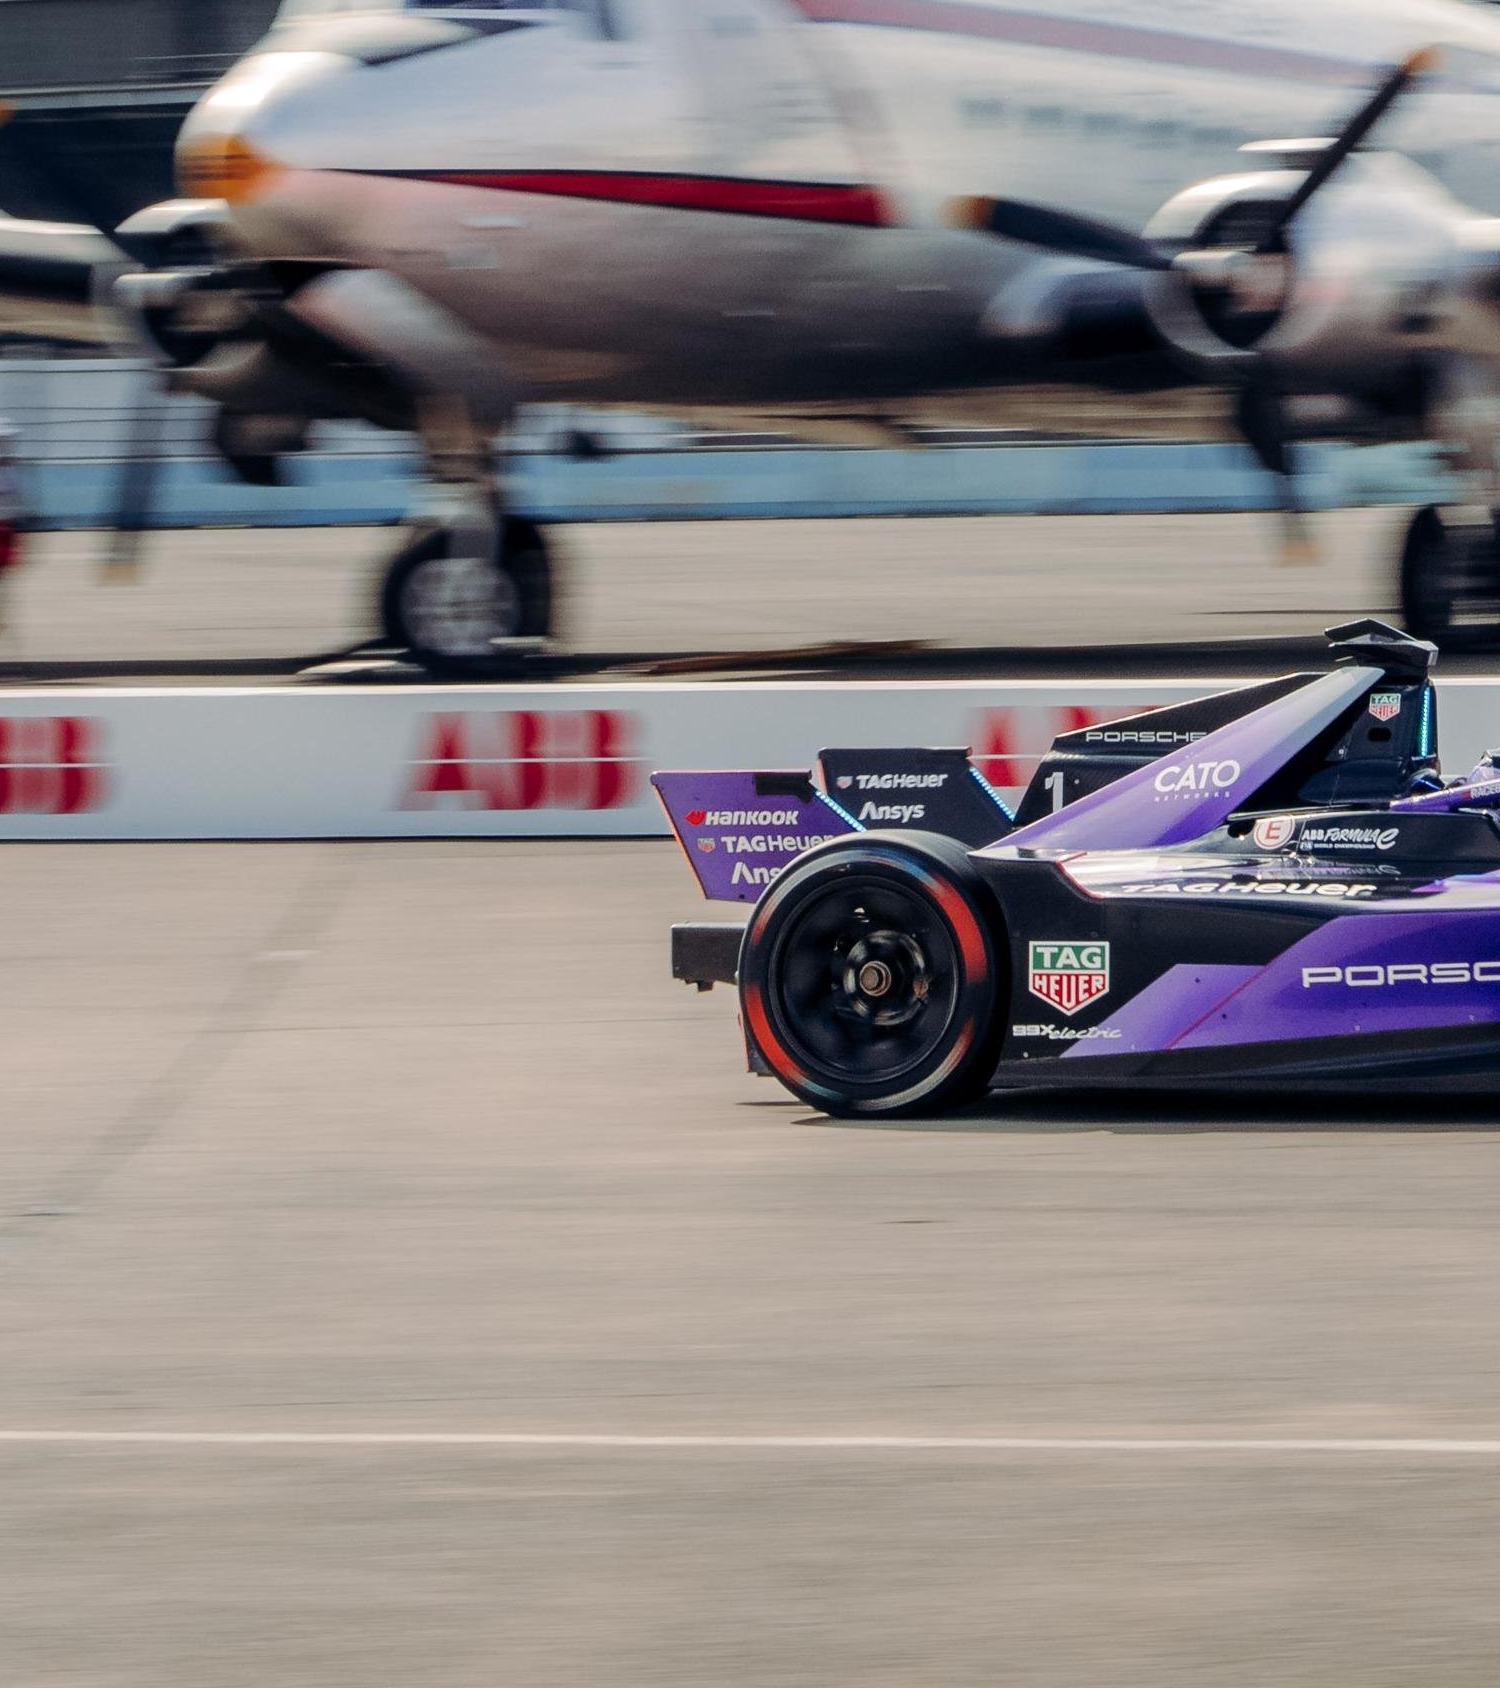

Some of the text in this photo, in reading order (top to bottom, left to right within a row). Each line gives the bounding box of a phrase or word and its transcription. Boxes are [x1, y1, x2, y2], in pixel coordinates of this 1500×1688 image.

[1373, 696, 1398, 704] TAG
[1086, 731, 1207, 743] PORSCHE
[398, 710, 646, 810] ABB
[1154, 759, 1241, 792] CATO
[858, 801, 925, 824] Ansys
[1267, 820, 1281, 840] E
[1302, 829, 1325, 841] ABB
[1035, 946, 1102, 969] TAG
[1034, 974, 1105, 1010] HEUER
